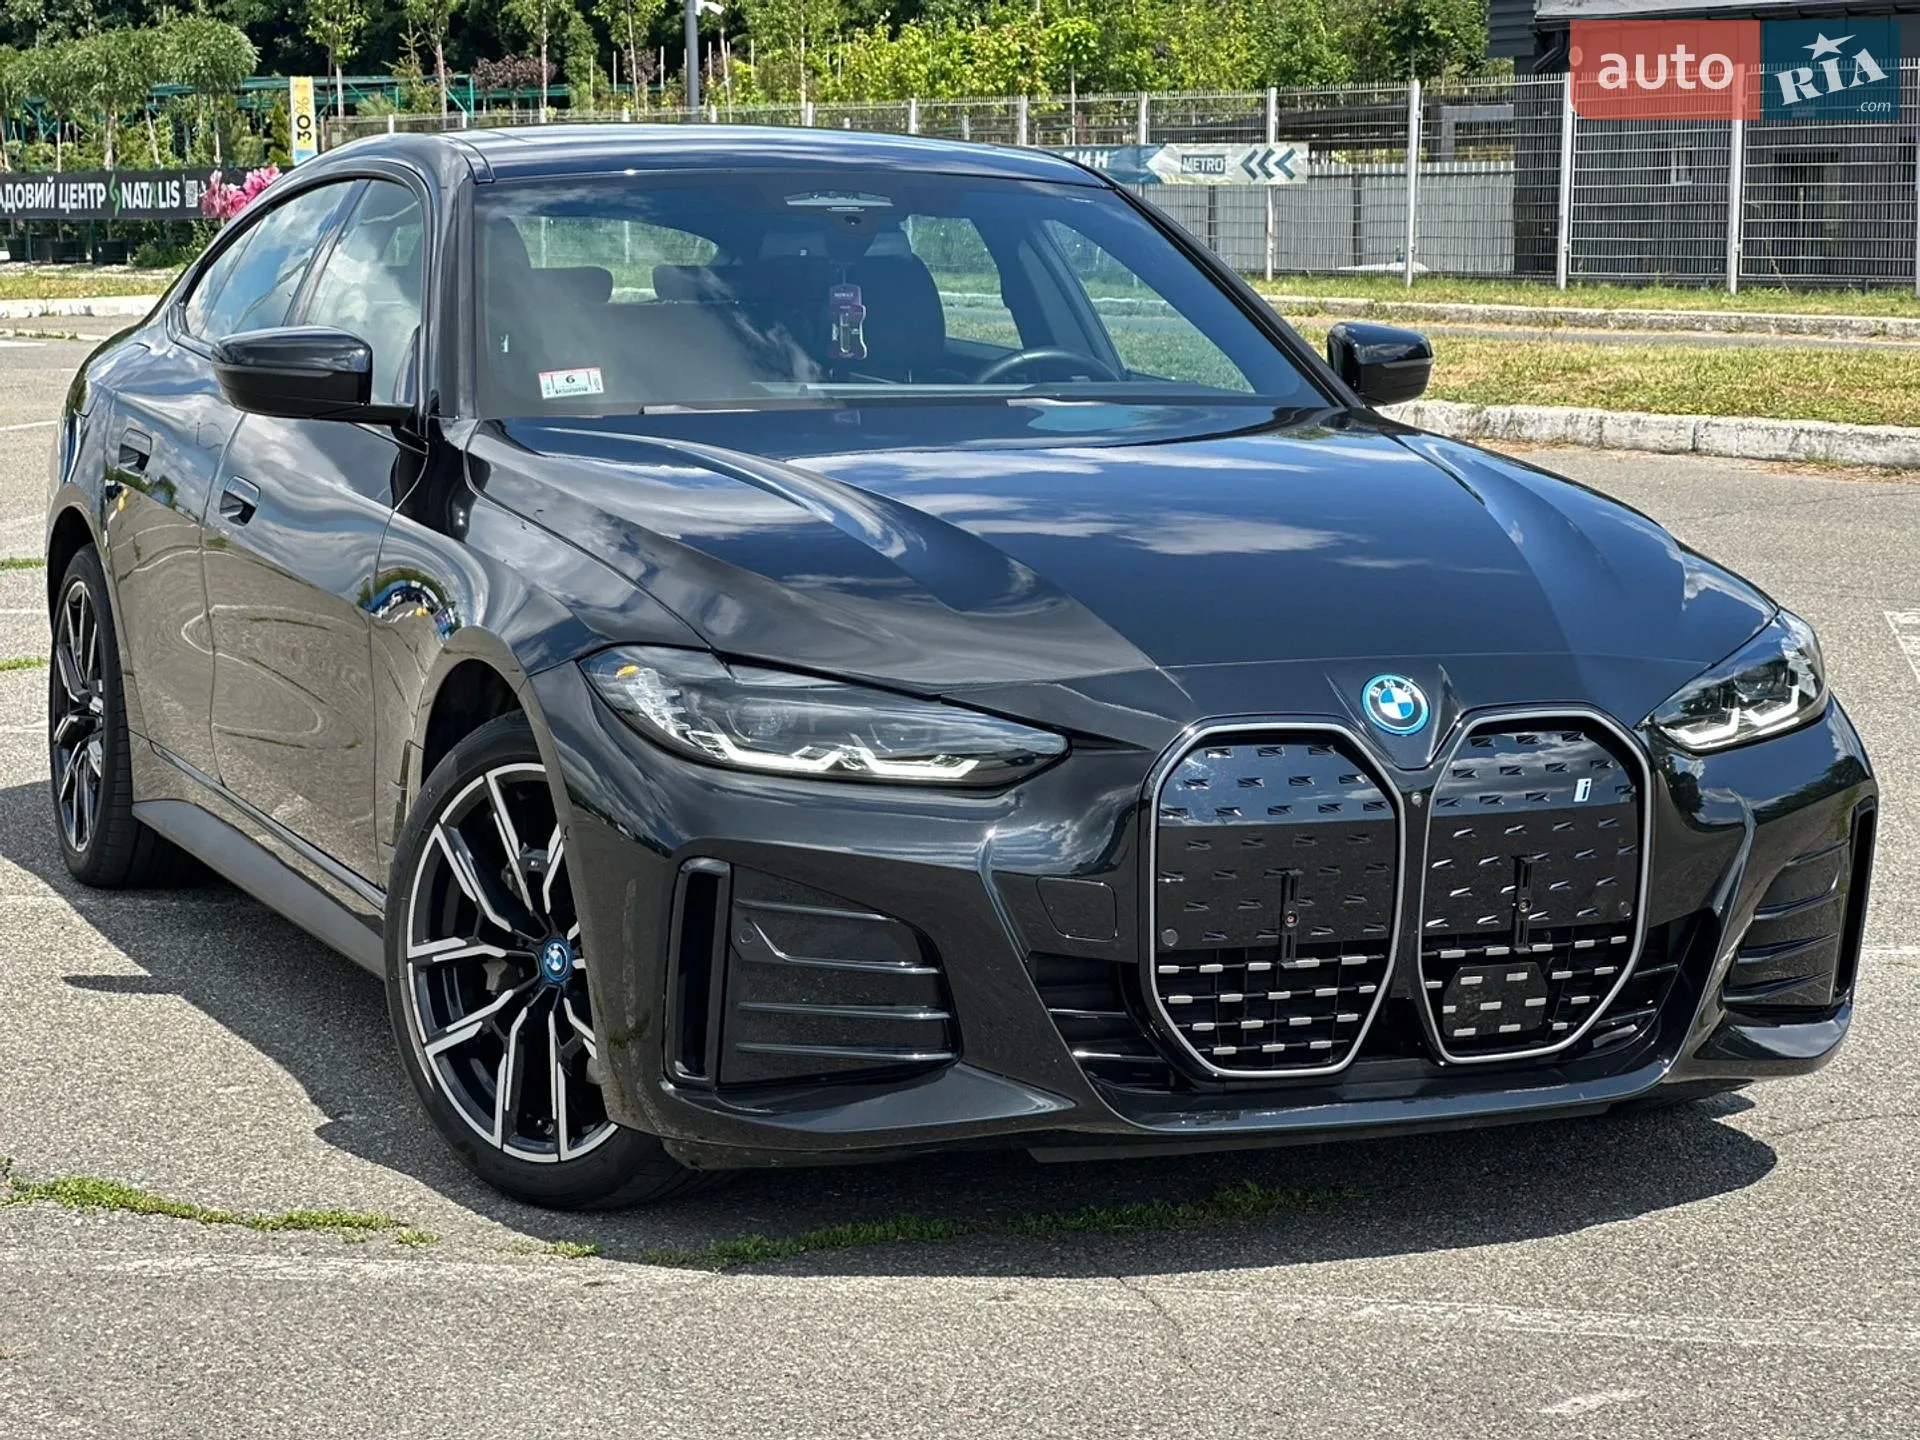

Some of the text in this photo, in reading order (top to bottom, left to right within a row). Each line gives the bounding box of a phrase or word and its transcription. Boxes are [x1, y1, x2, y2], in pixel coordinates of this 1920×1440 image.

[1182, 156, 1225, 171] METRO
[58, 182, 107, 214] ЦЕНТР
[121, 180, 181, 209] NATALIS
[1369, 679, 1415, 698] BMW
